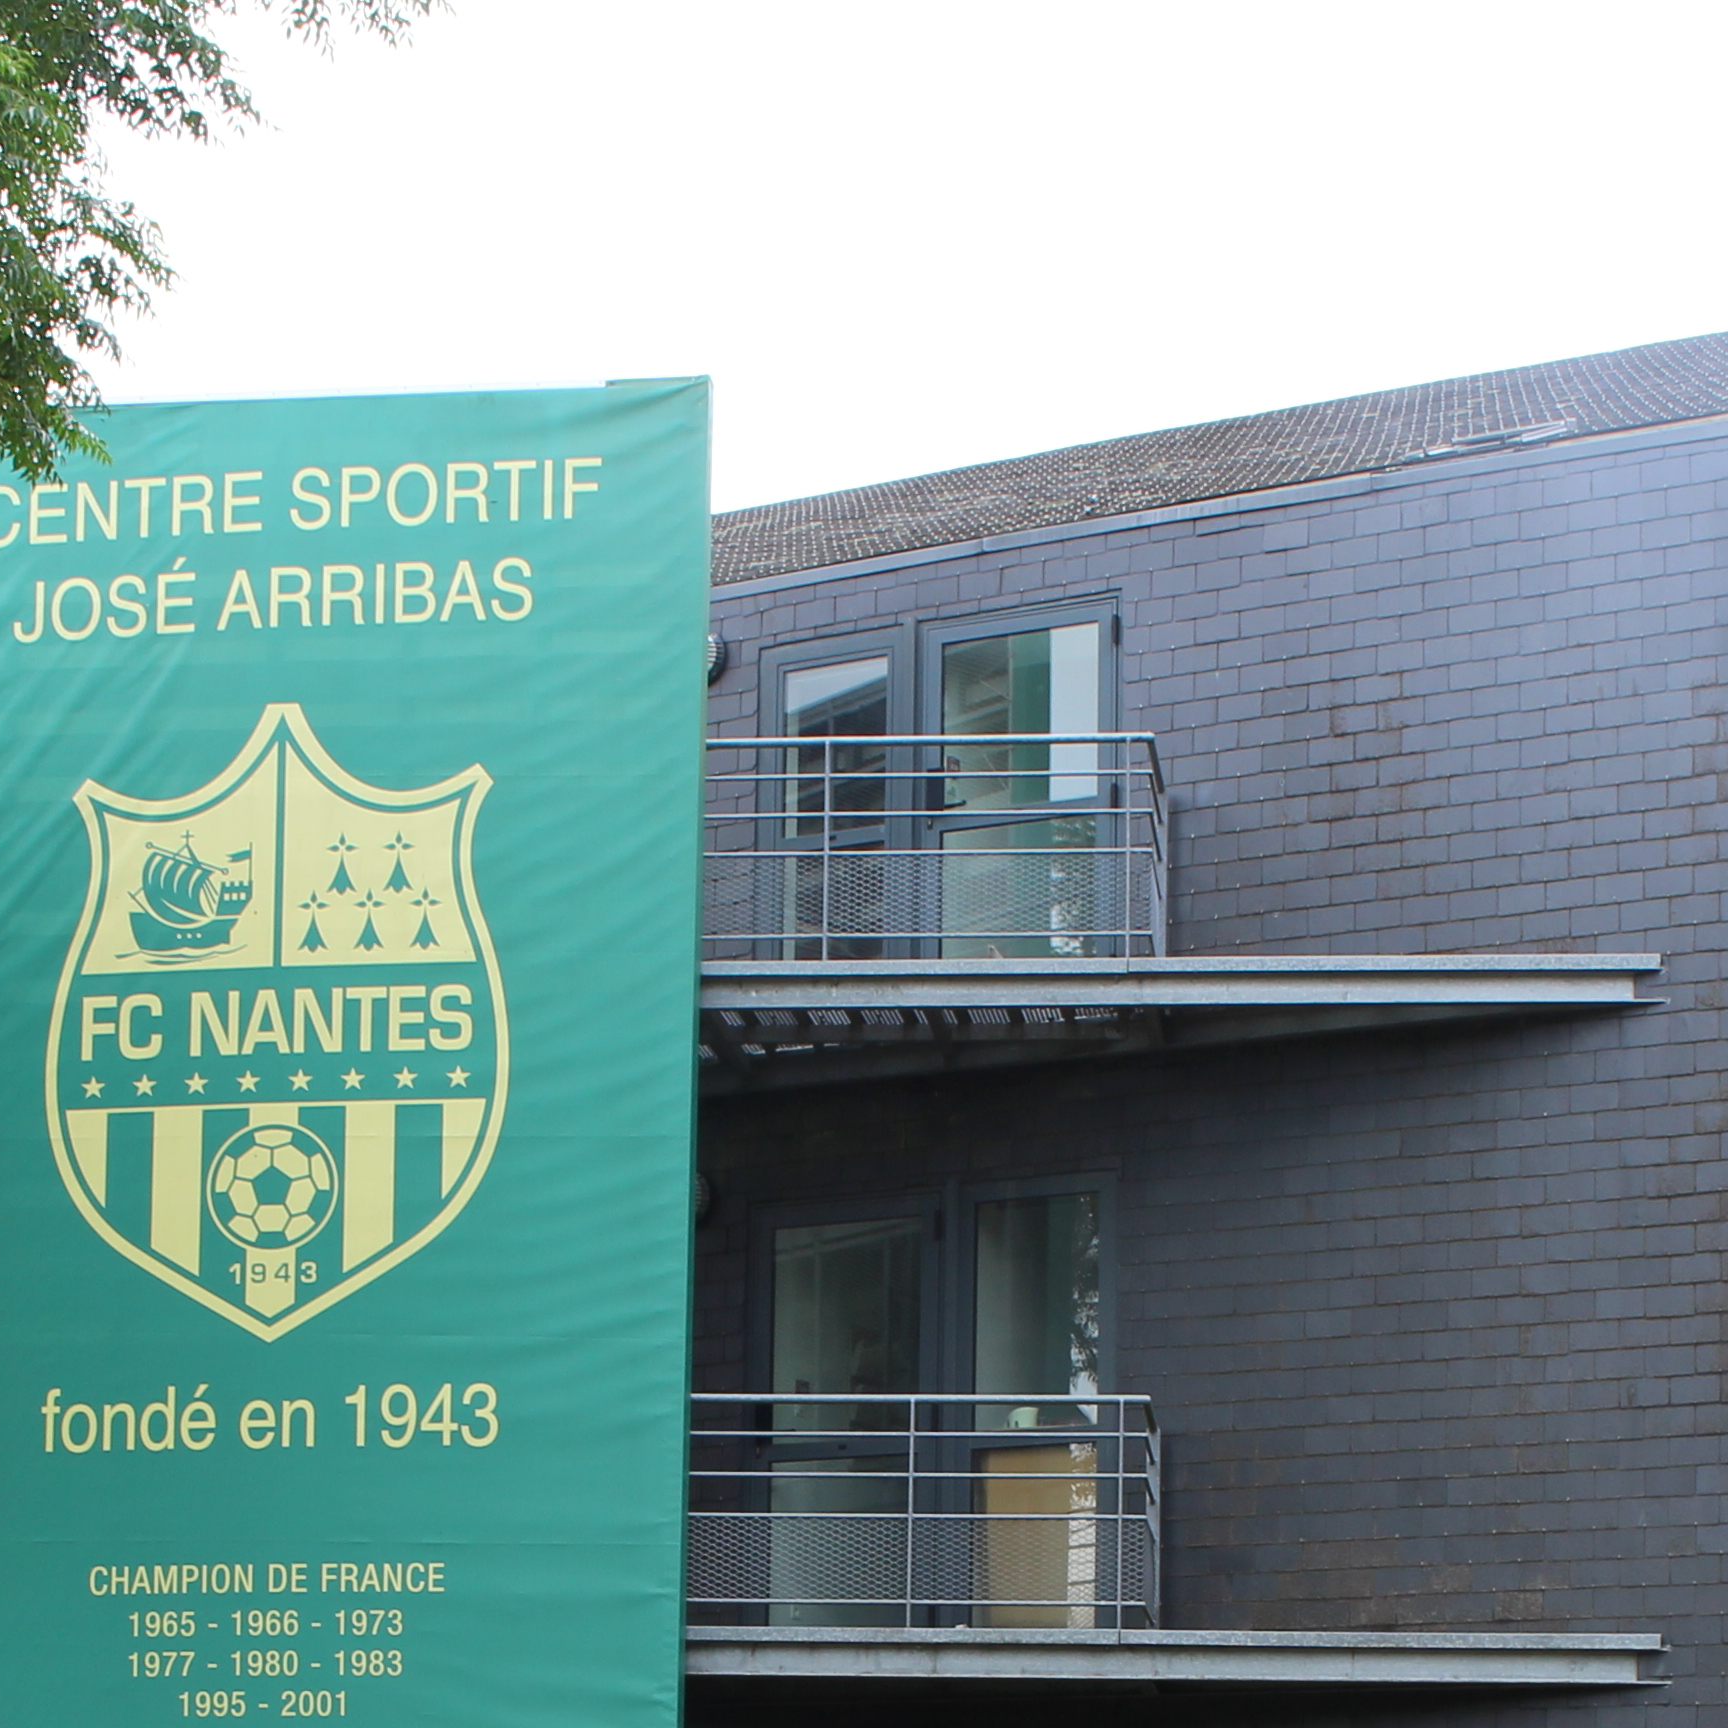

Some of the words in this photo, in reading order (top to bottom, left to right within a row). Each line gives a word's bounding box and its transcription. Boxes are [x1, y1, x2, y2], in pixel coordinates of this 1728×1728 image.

[289, 455, 604, 530] SPORTIF
[12, 555, 197, 643] JOSÉ
[216, 554, 534, 630] ARRIBAS
[79, 991, 164, 1062] FC
[188, 981, 474, 1057] NANTES
[228, 1260, 319, 1285] 1943
[39, 1382, 217, 1453] fondé
[238, 1397, 316, 1450] en
[343, 1381, 500, 1449] 1943
[88, 1562, 255, 1597] CHAMPION
[267, 1562, 308, 1594] DE
[320, 1561, 446, 1593] FRANCE
[128, 1609, 196, 1638] 1965
[231, 1608, 299, 1637] 1966
[335, 1608, 404, 1636] 1973
[128, 1650, 195, 1678] 1977
[230, 1649, 299, 1677] 1980
[334, 1648, 403, 1677] 1983
[178, 1689, 246, 1718] 1995
[280, 1689, 347, 1718] 2001
